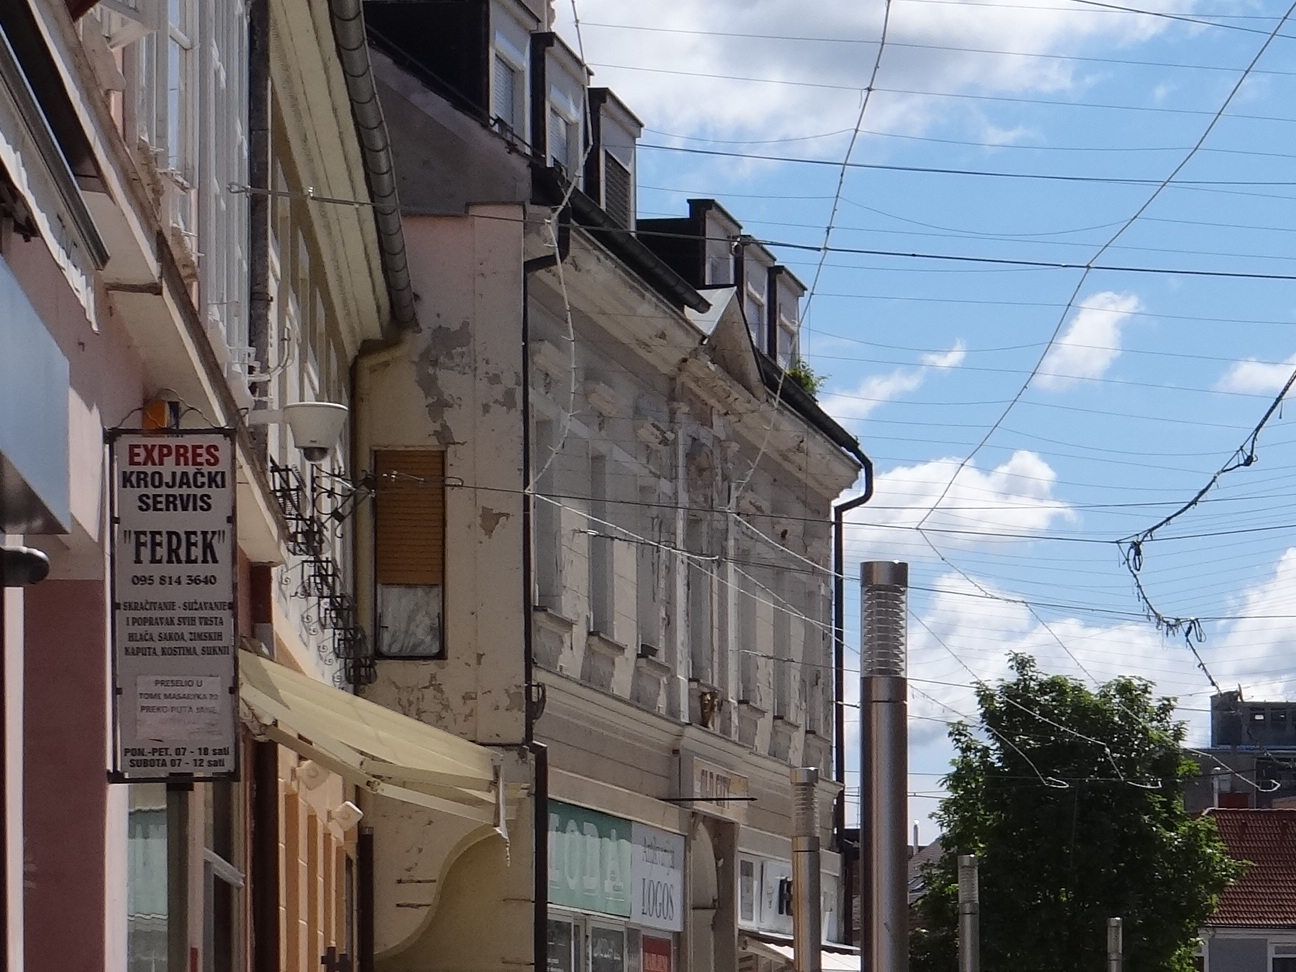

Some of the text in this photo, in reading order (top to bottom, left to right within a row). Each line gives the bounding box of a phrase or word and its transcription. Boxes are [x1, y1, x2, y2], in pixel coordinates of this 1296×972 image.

[128, 443, 220, 467] EXPRES
[122, 467, 226, 489] KROJAČKI
[137, 493, 212, 512] SERVIS
[123, 529, 226, 565] "FEREK"
[131, 575, 217, 586] 095 814 3640
[131, 617, 175, 626] POPRAVAK
[176, 617, 196, 626] SVIH
[198, 616, 224, 626] VRSTA
[188, 632, 223, 641] ZIMSKIH
[175, 747, 187, 757] 07
[212, 745, 230, 756] sati
[129, 758, 167, 768] SUBOTA
[170, 758, 182, 768] 07
[193, 758, 205, 768] 12
[207, 758, 225, 768] sati
[641, 878, 675, 920] LOGOS
